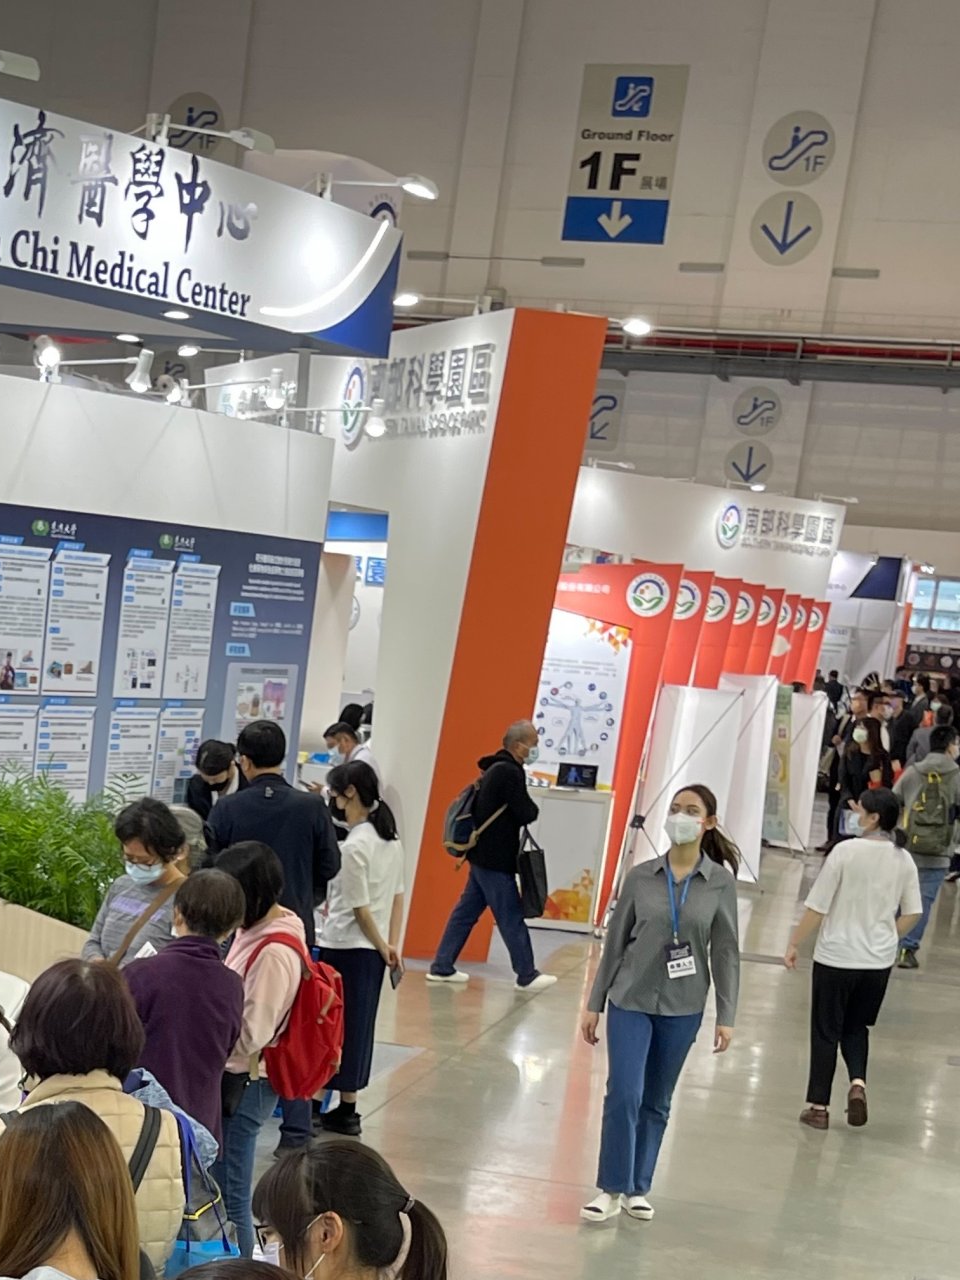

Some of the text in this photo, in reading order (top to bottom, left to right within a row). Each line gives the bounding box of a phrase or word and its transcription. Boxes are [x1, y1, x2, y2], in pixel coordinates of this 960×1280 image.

[581, 128, 674, 143] Ground Floor
[580, 151, 641, 191] 1F
[803, 156, 827, 172] 1F
[10, 229, 60, 276] Chi
[67, 246, 169, 300] Medical
[176, 268, 251, 318] Center
[759, 416, 774, 427] 1F
